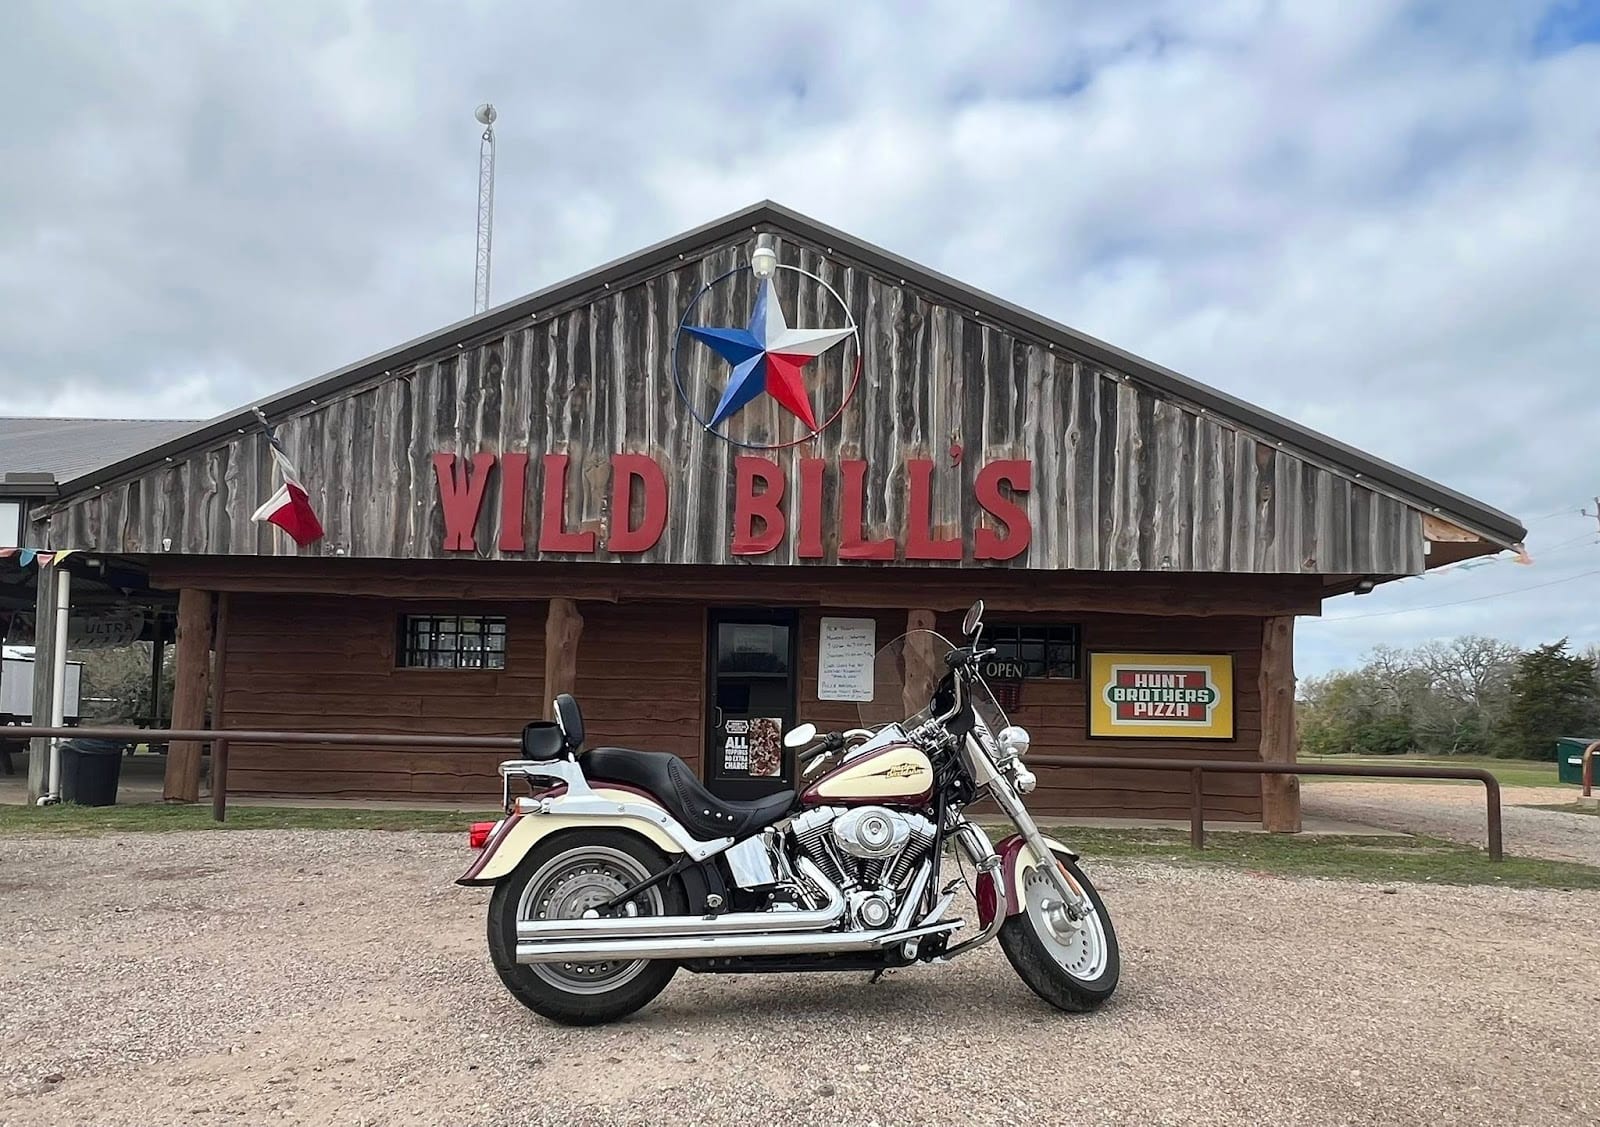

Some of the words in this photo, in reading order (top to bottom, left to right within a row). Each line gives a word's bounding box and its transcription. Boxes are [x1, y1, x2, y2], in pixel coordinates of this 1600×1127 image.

[433, 453, 669, 553] WILD
[731, 444, 1032, 561] BILL'S
[86, 622, 134, 634] ULTRA
[986, 662, 1023, 678] OPEN
[1135, 674, 1187, 688] HUNT
[1113, 688, 1209, 702] BROTHERS
[1133, 702, 1189, 717] PIZZA
[725, 736, 748, 749] ALL
[725, 761, 748, 769] CHARGE
